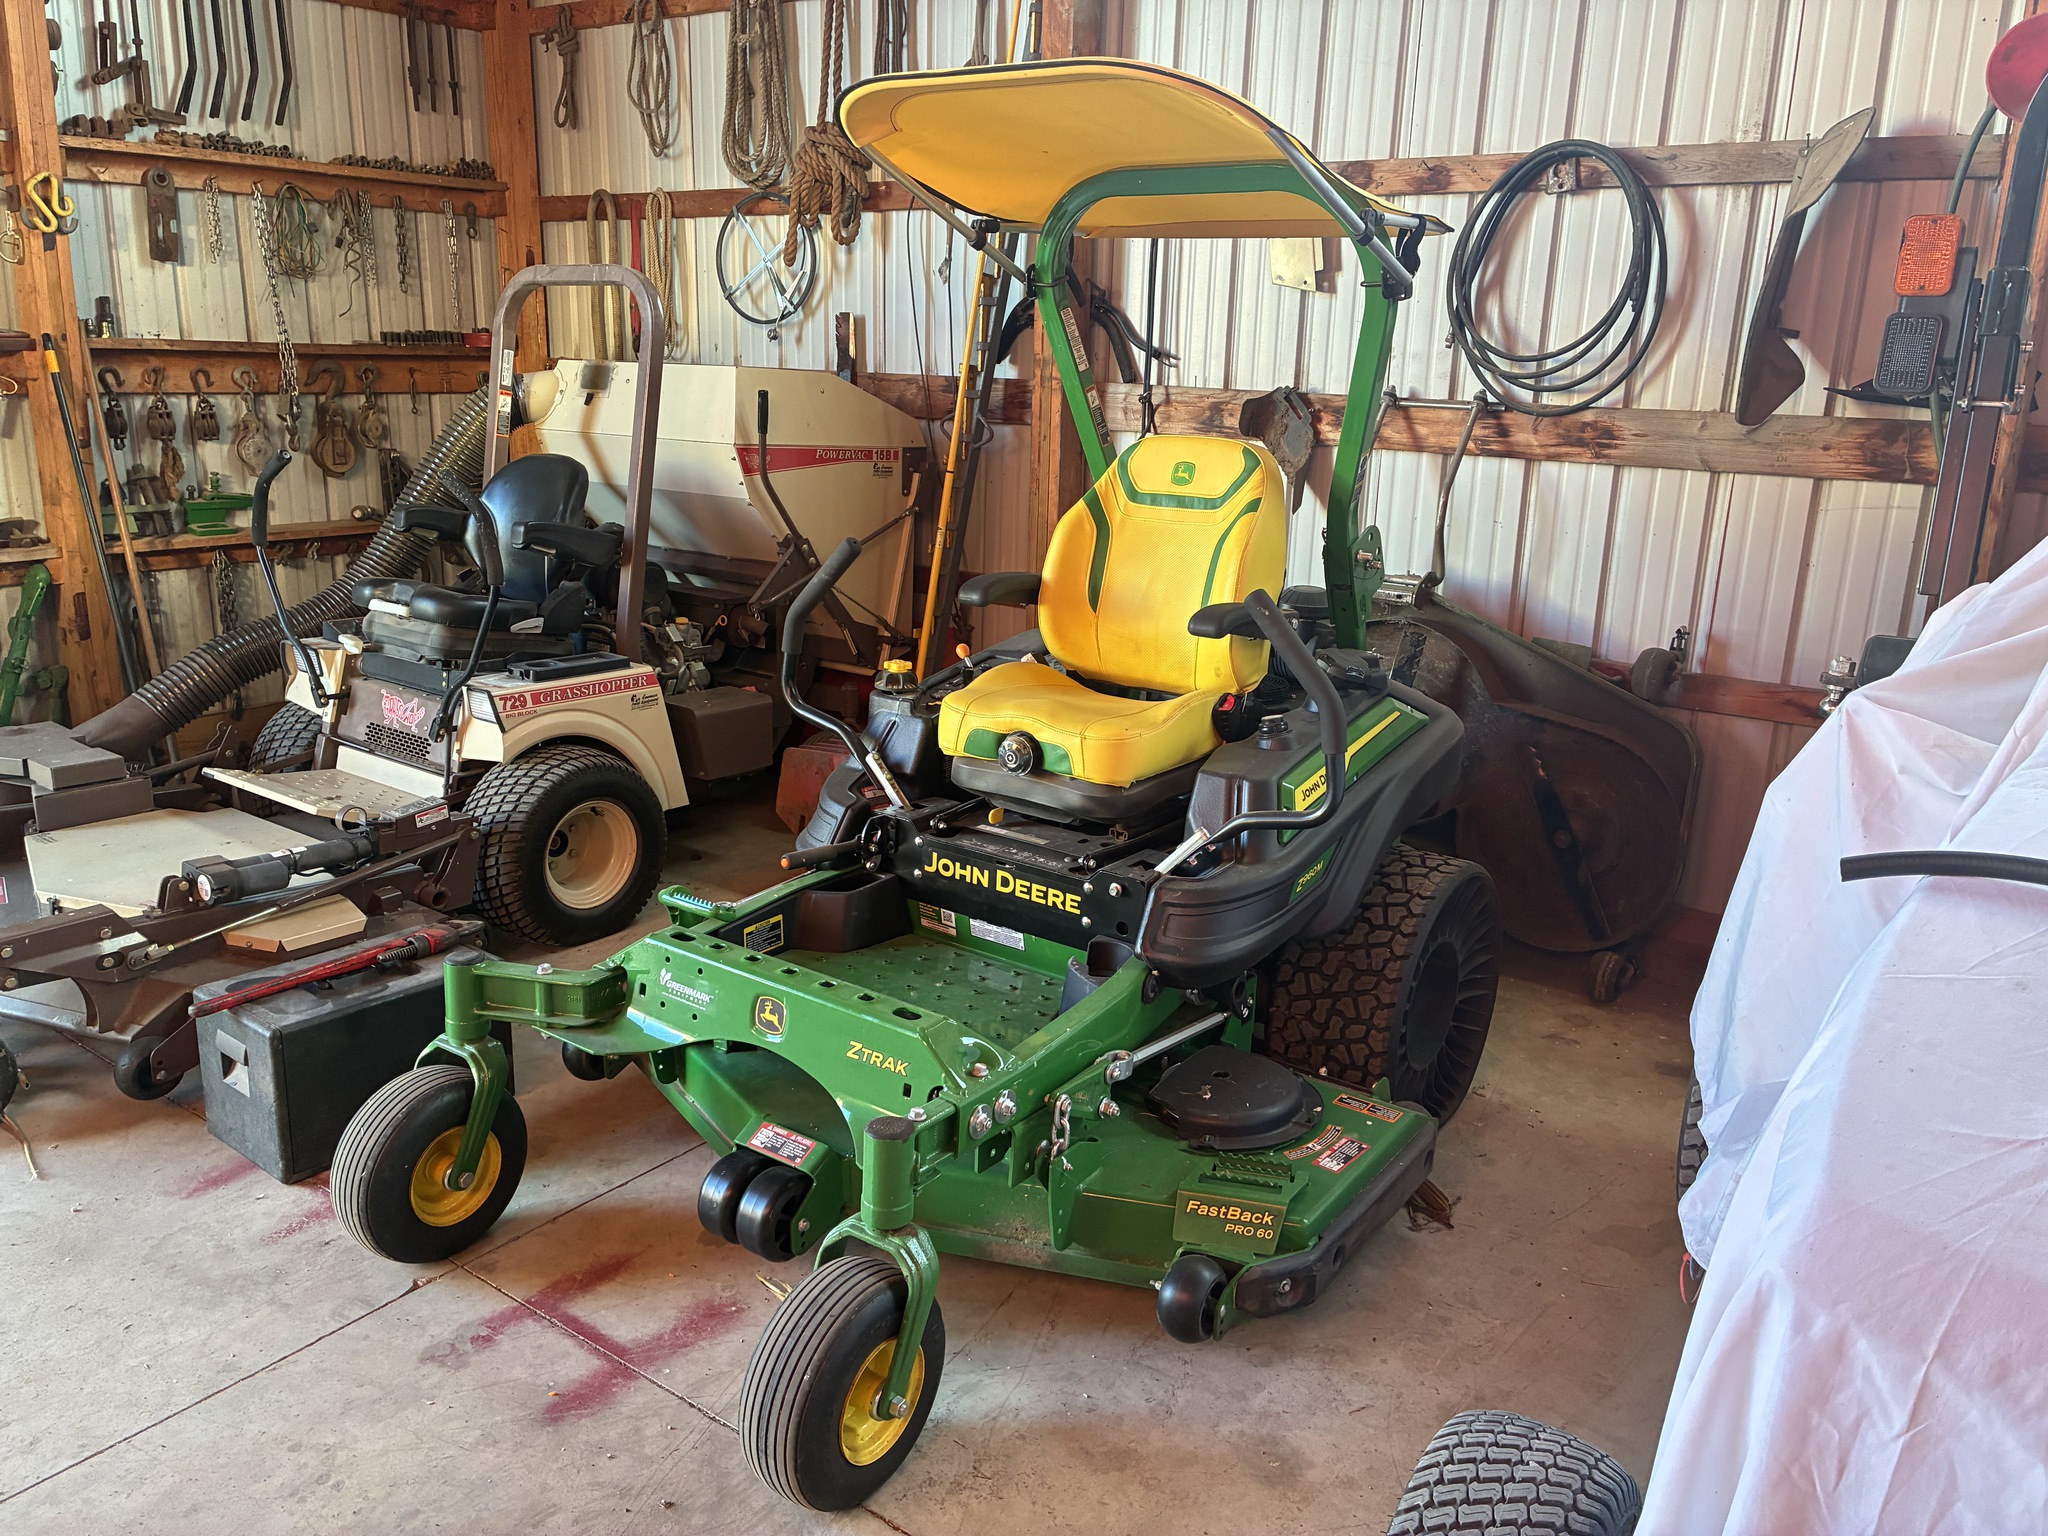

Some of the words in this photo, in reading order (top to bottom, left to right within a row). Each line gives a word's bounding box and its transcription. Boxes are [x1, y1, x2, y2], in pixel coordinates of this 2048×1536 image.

[499, 693, 528, 711] 729
[540, 675, 648, 703] GRASSHOPPER
[518, 709, 538, 718] BLOCK
[1301, 780, 1321, 802] JOHN
[924, 852, 989, 888] JOHN
[996, 869, 1082, 915] DEERE
[1296, 860, 1324, 893] Z960M
[666, 980, 710, 1003] GREENMARK
[846, 1040, 910, 1076] ZTRAK
[1186, 1200, 1275, 1226] FastBack
[1224, 1223, 1255, 1237] PRO
[1256, 1228, 1274, 1240] 60
